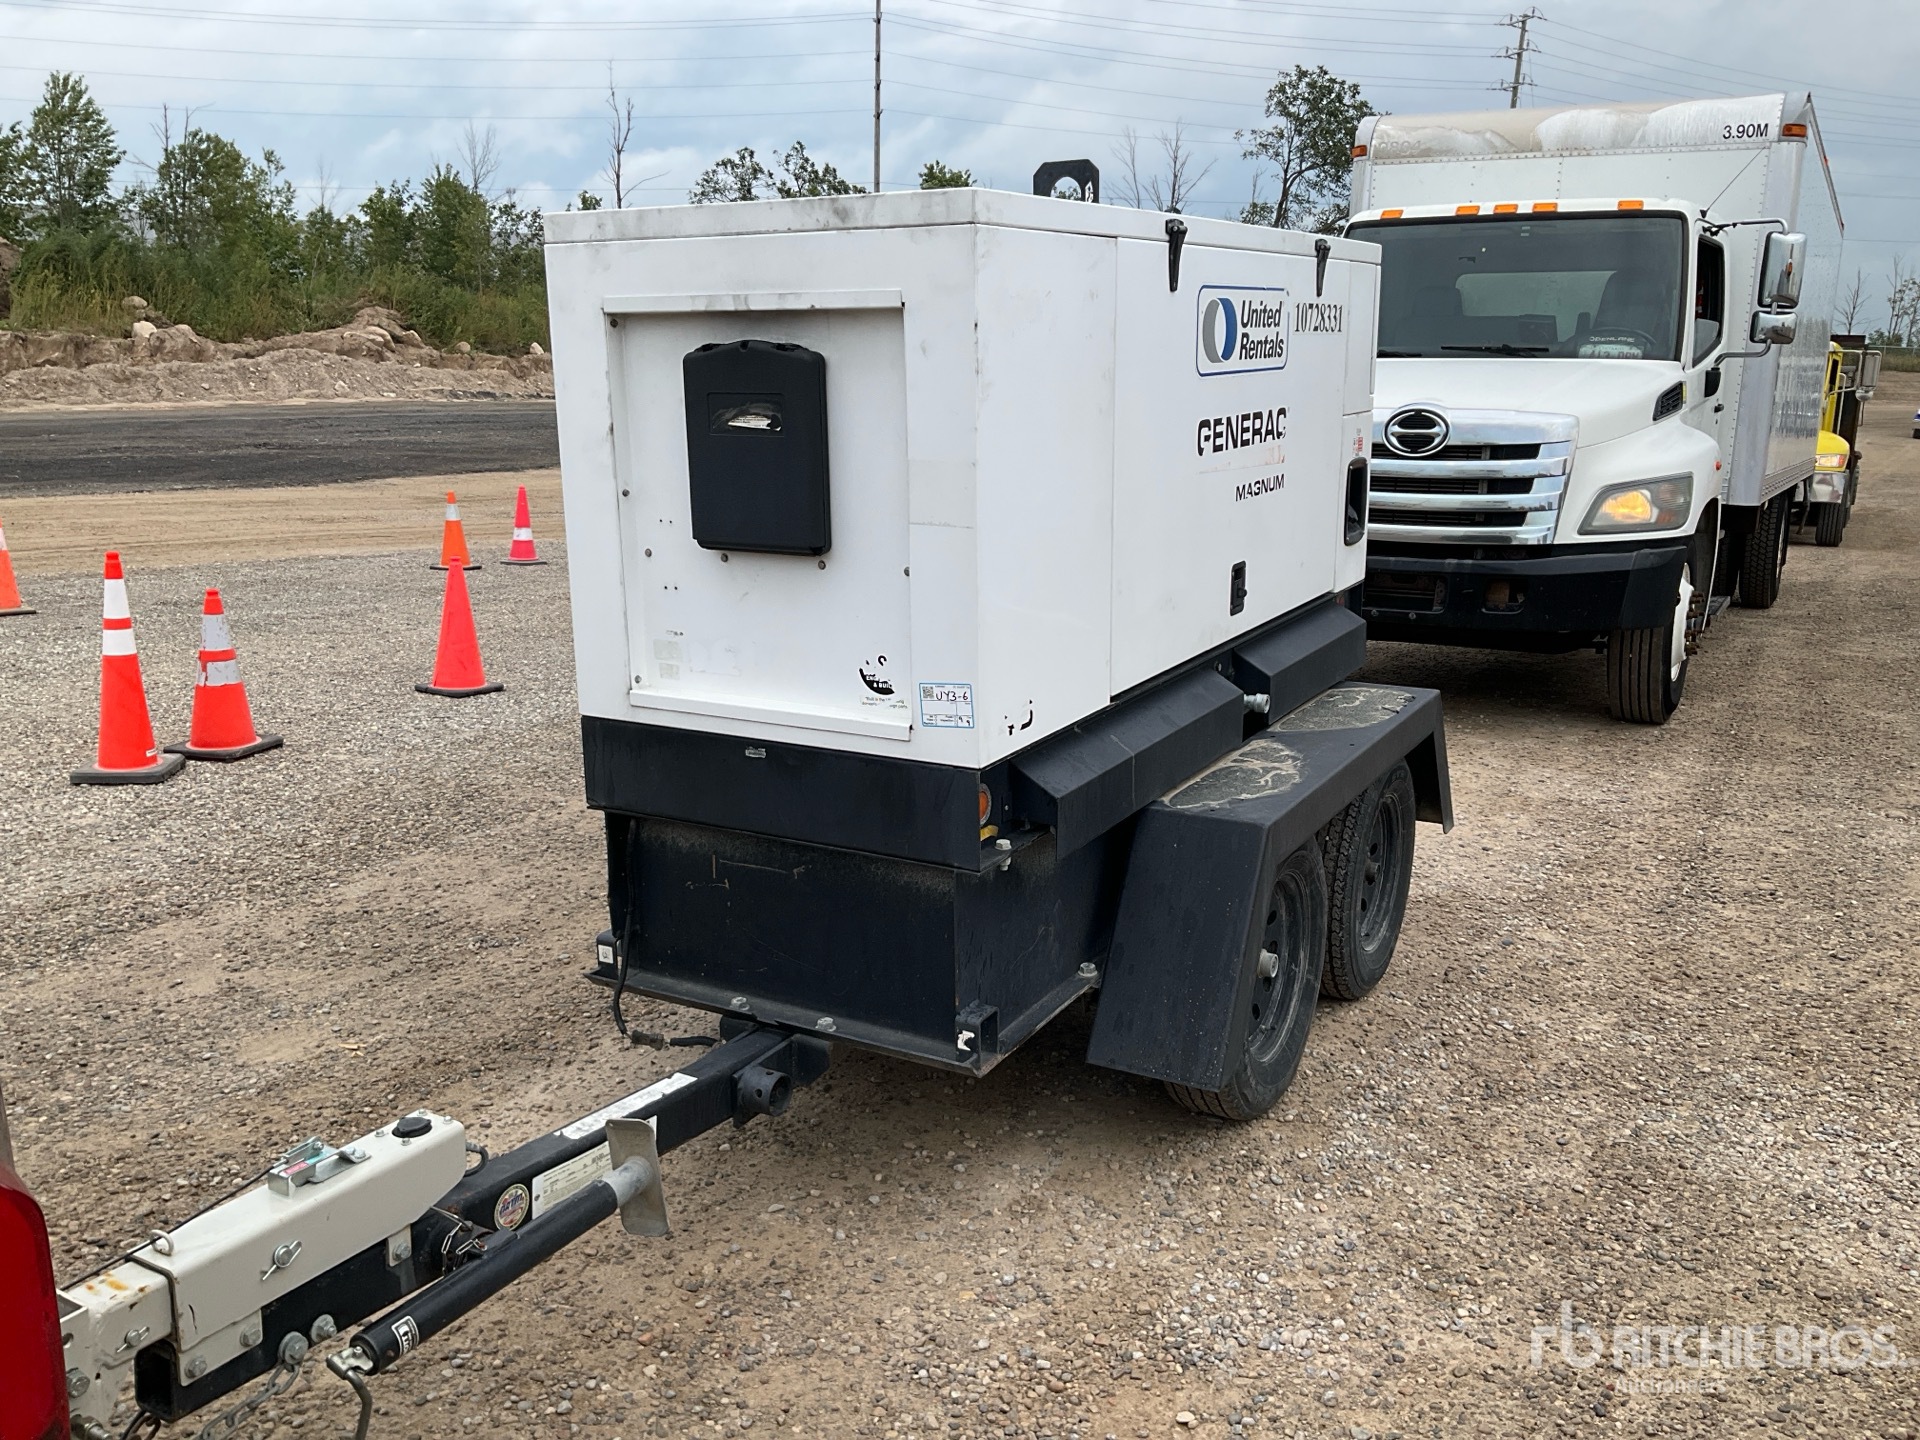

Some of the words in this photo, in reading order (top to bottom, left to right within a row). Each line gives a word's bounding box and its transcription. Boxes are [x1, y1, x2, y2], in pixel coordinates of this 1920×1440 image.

[1722, 123, 1769, 139] 3.90M
[1240, 299, 1282, 329] United
[1294, 304, 1343, 333] 10728331
[1239, 331, 1284, 361] Rentals
[1197, 407, 1287, 456] GENERAC
[1235, 473, 1285, 502] MAGNUM
